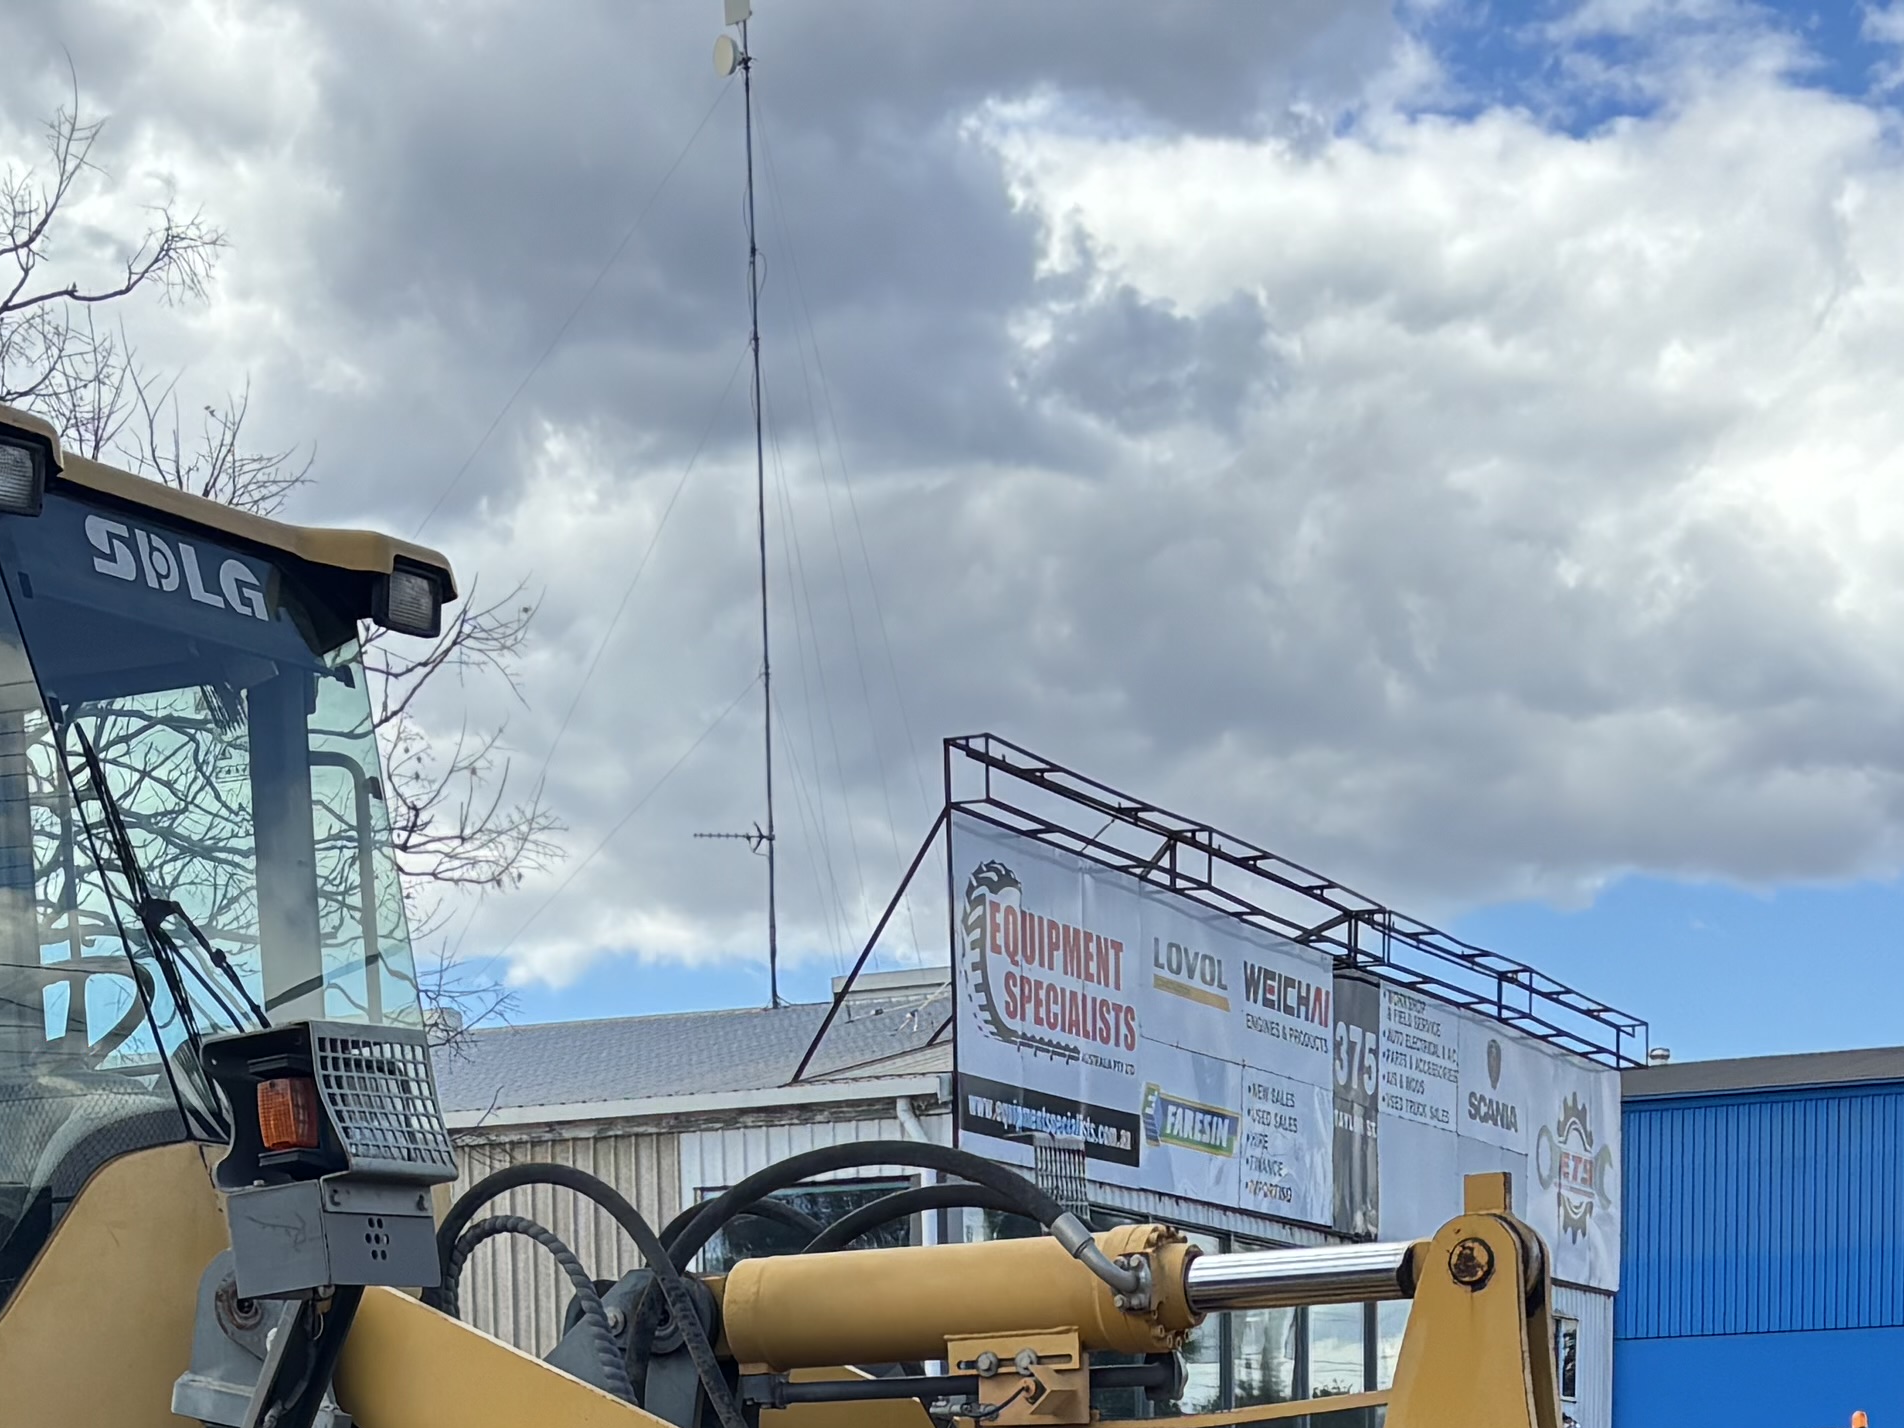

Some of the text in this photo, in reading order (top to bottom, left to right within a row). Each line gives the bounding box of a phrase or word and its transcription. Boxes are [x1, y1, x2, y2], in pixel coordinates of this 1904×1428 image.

[85, 514, 271, 621] SDLG
[989, 899, 1124, 991] EQUIPMENT
[1154, 937, 1228, 990] LOVOL
[1004, 970, 1136, 1052] SPECIALISTS
[1243, 960, 1330, 1028] WEICHAI
[1246, 1013, 1280, 1039] ENGINES
[1289, 1027, 1328, 1053] PRODUCTS
[1335, 1021, 1376, 1095] 375
[1271, 1087, 1295, 1108] SALES
[1429, 1101, 1450, 1124] SALES
[1467, 1091, 1518, 1133] SCANIA
[1166, 1105, 1230, 1148] FARESIN
[1274, 1113, 1297, 1133] SALES
